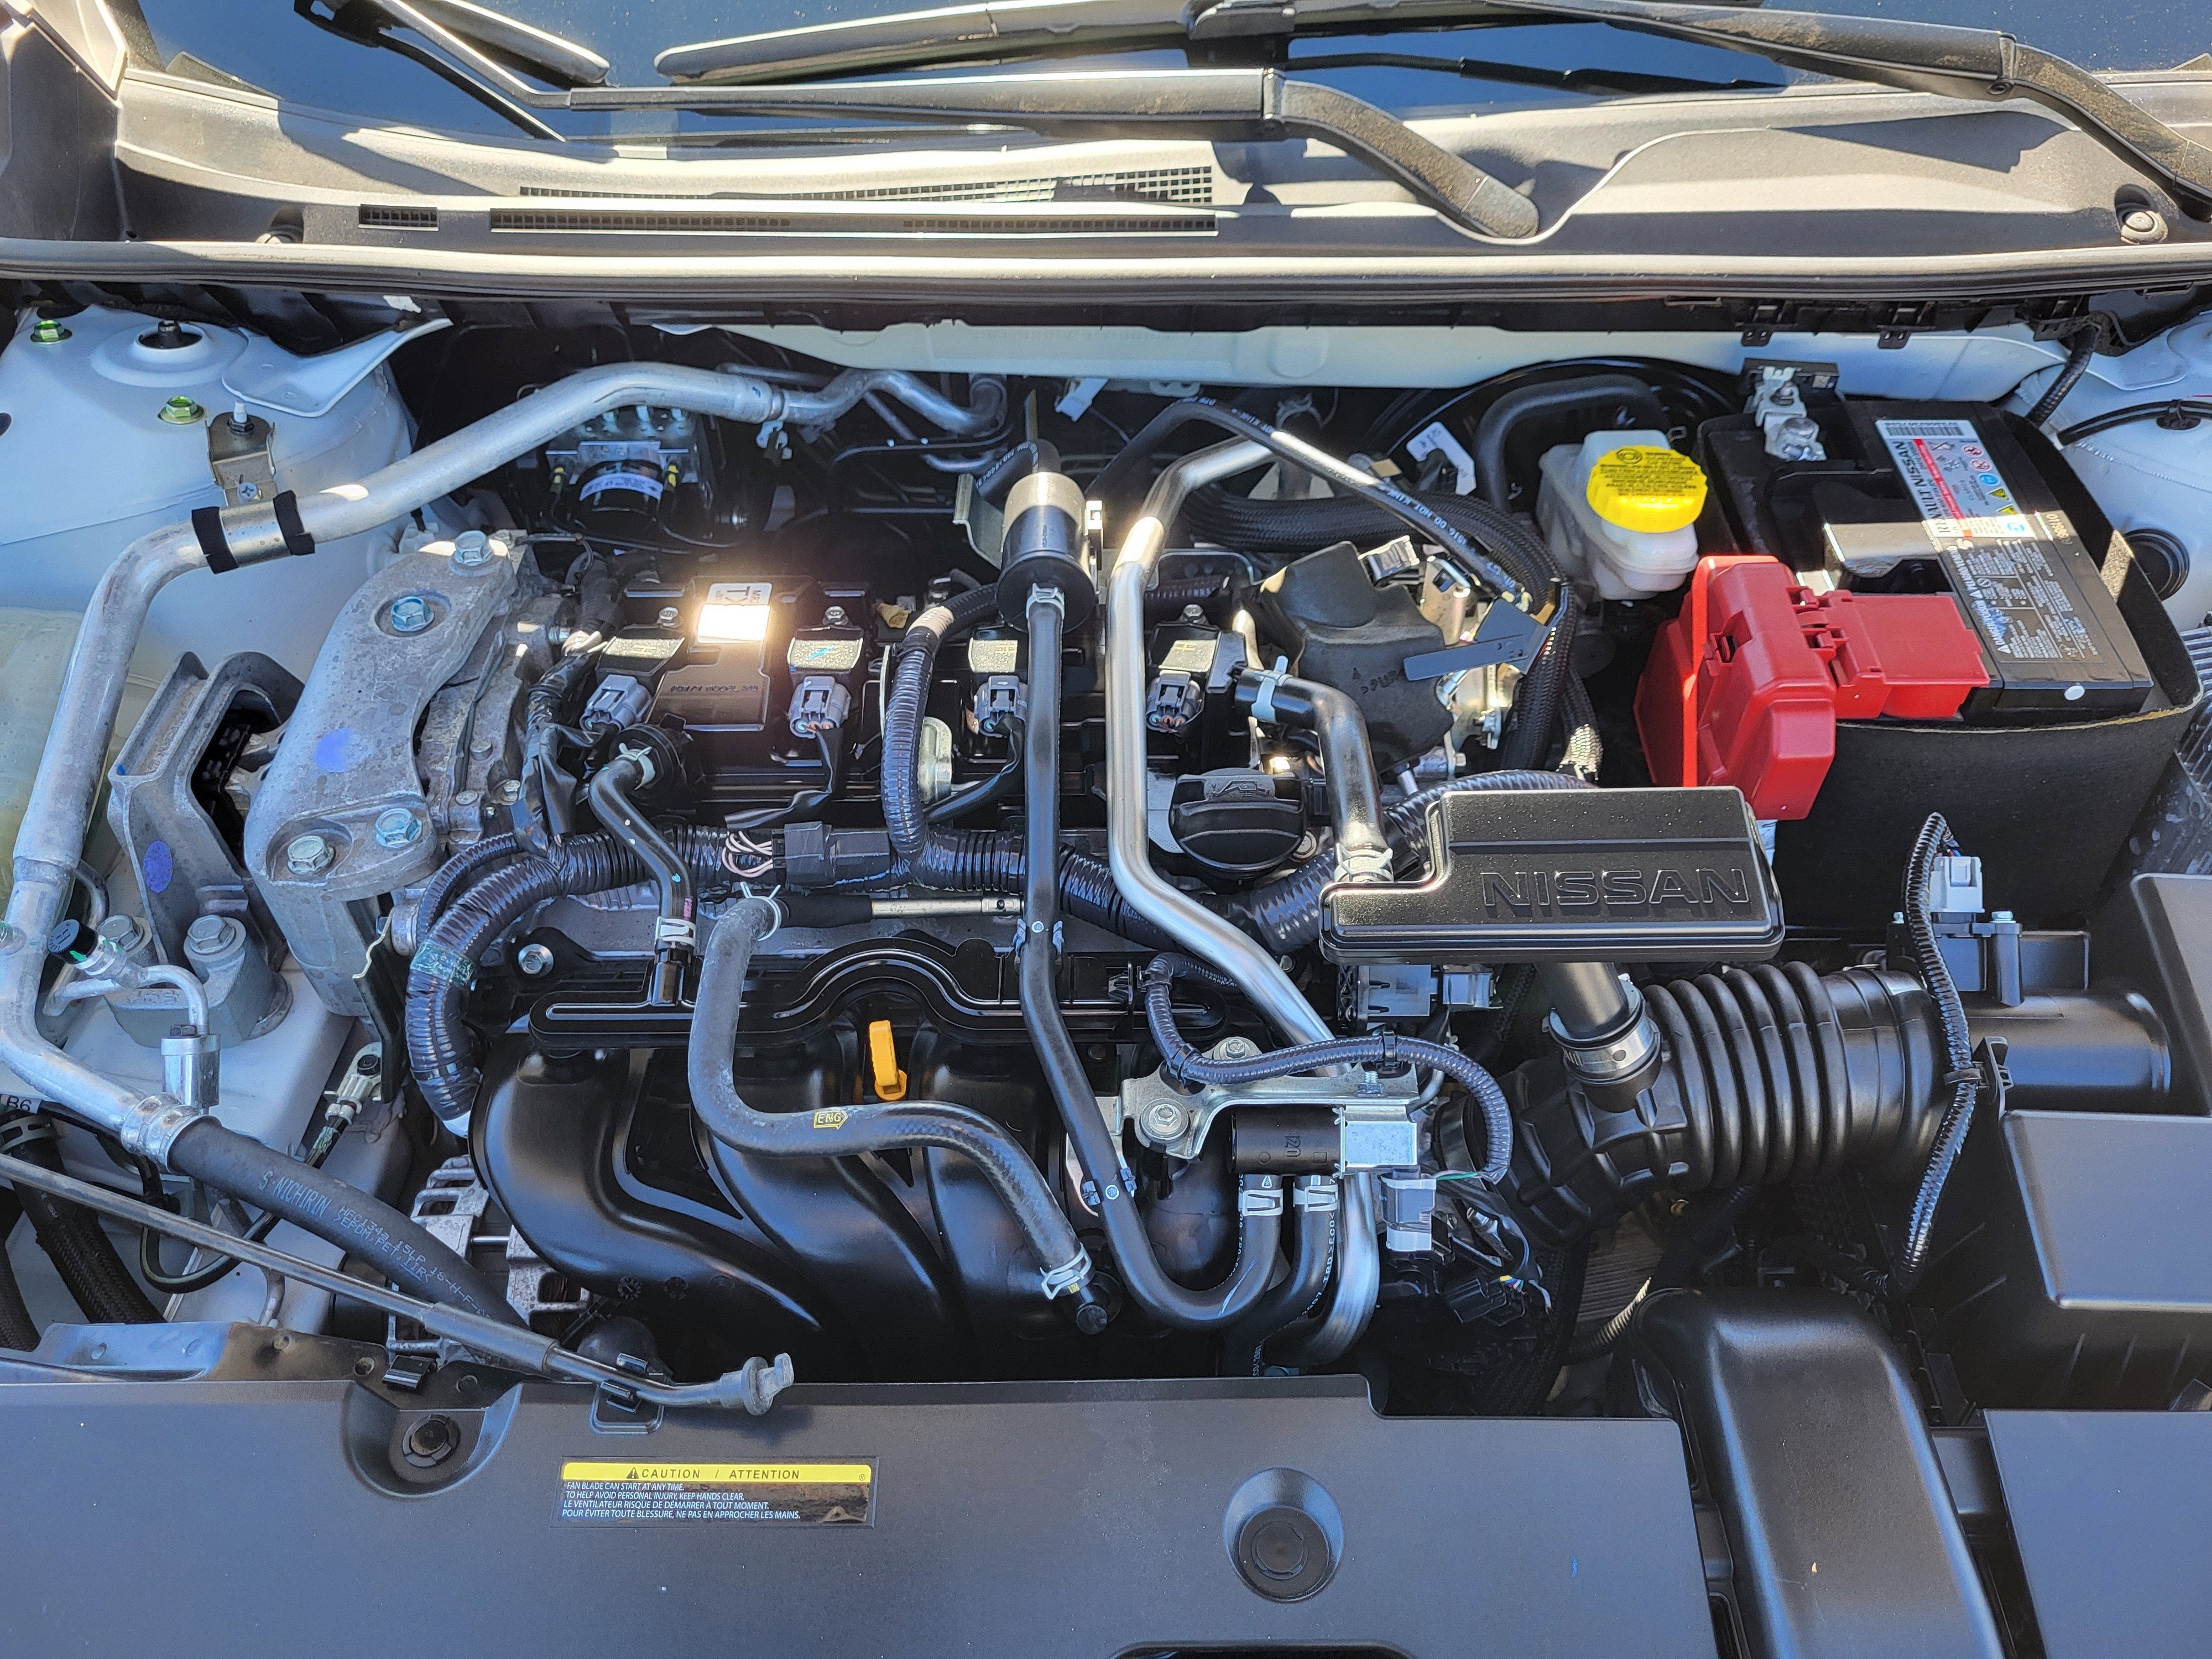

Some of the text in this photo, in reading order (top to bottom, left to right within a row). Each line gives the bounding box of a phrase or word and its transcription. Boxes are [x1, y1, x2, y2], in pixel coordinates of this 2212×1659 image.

[1891, 441, 1927, 487] NISSAN
[1481, 869, 1750, 906] NISSAN
[7, 1095, 32, 1112] B6
[818, 1112, 841, 1123] ENG
[1284, 1130, 1301, 1157] 120
[641, 1469, 700, 1479] CAUTION
[729, 1470, 800, 1479] ATTENTION
[604, 1482, 620, 1490] CAN
[617, 1491, 653, 1500] PERSONAL
[654, 1492, 677, 1501] INJURY,
[679, 1492, 696, 1500] KEEP
[574, 1500, 623, 1508] VENTILATEUR
[624, 1500, 651, 1509] RISQUE
[664, 1499, 705, 1509] DÉMARRER
[706, 1499, 711, 1509] À
[712, 1501, 733, 1510] TOUT
[734, 1501, 769, 1510] MOMENT.
[585, 1508, 609, 1517] ÉVITER
[637, 1510, 675, 1519] BLESSURE,
[714, 1511, 759, 1519] APPROCHER
[760, 1511, 773, 1519] LES
[774, 1511, 801, 1520] MAINS.
